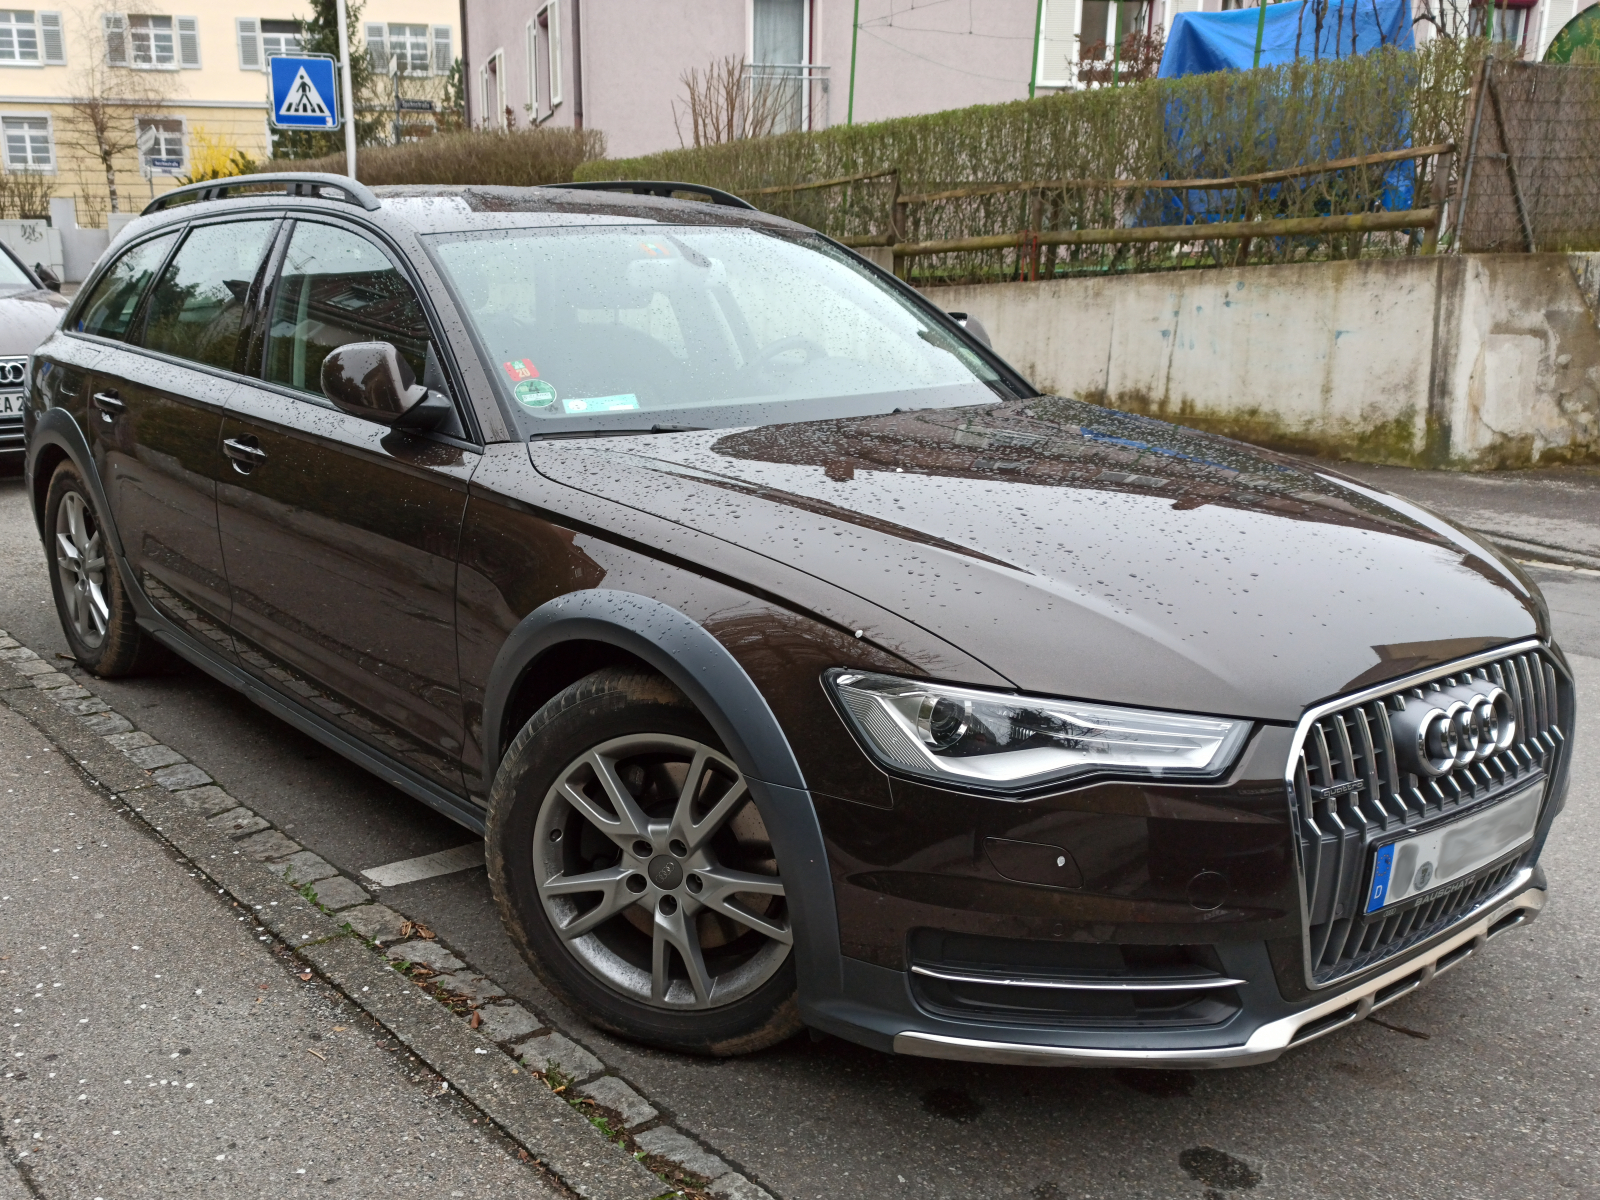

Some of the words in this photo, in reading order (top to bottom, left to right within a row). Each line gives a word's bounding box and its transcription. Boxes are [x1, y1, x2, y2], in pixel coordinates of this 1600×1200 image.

[1323, 781, 1364, 797] quattro
[1374, 885, 1383, 899] D
[1415, 875, 1476, 907] BAUSCHATZ
